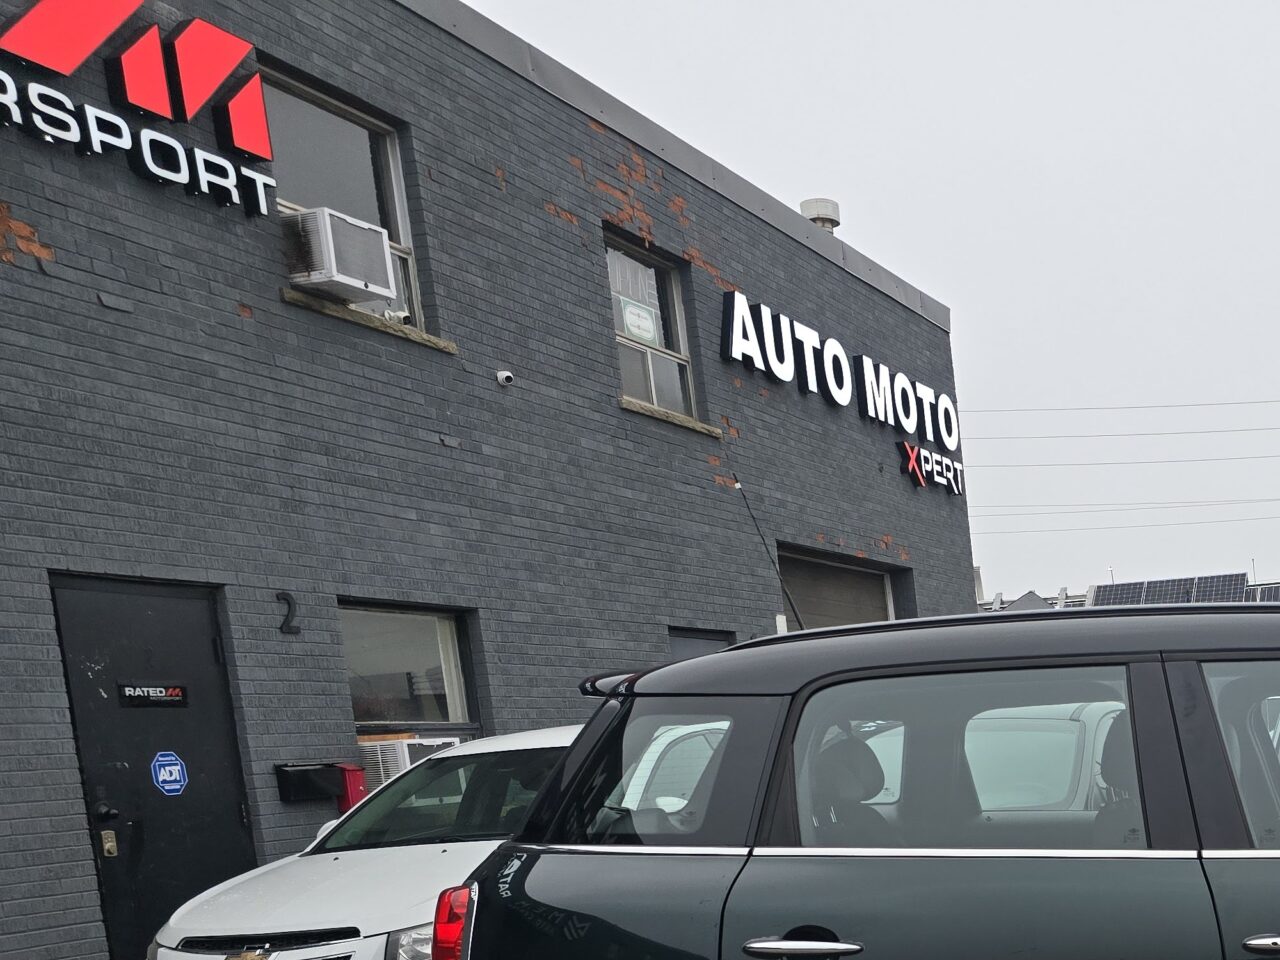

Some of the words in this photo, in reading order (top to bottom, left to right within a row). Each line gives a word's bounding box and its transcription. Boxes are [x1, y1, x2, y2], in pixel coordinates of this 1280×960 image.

[731, 290, 852, 407] AUTO
[861, 354, 959, 452] MOTO
[903, 441, 963, 496] XPERT
[276, 592, 300, 634] 2
[124, 687, 166, 697] RATED
[160, 766, 181, 782] ADT
